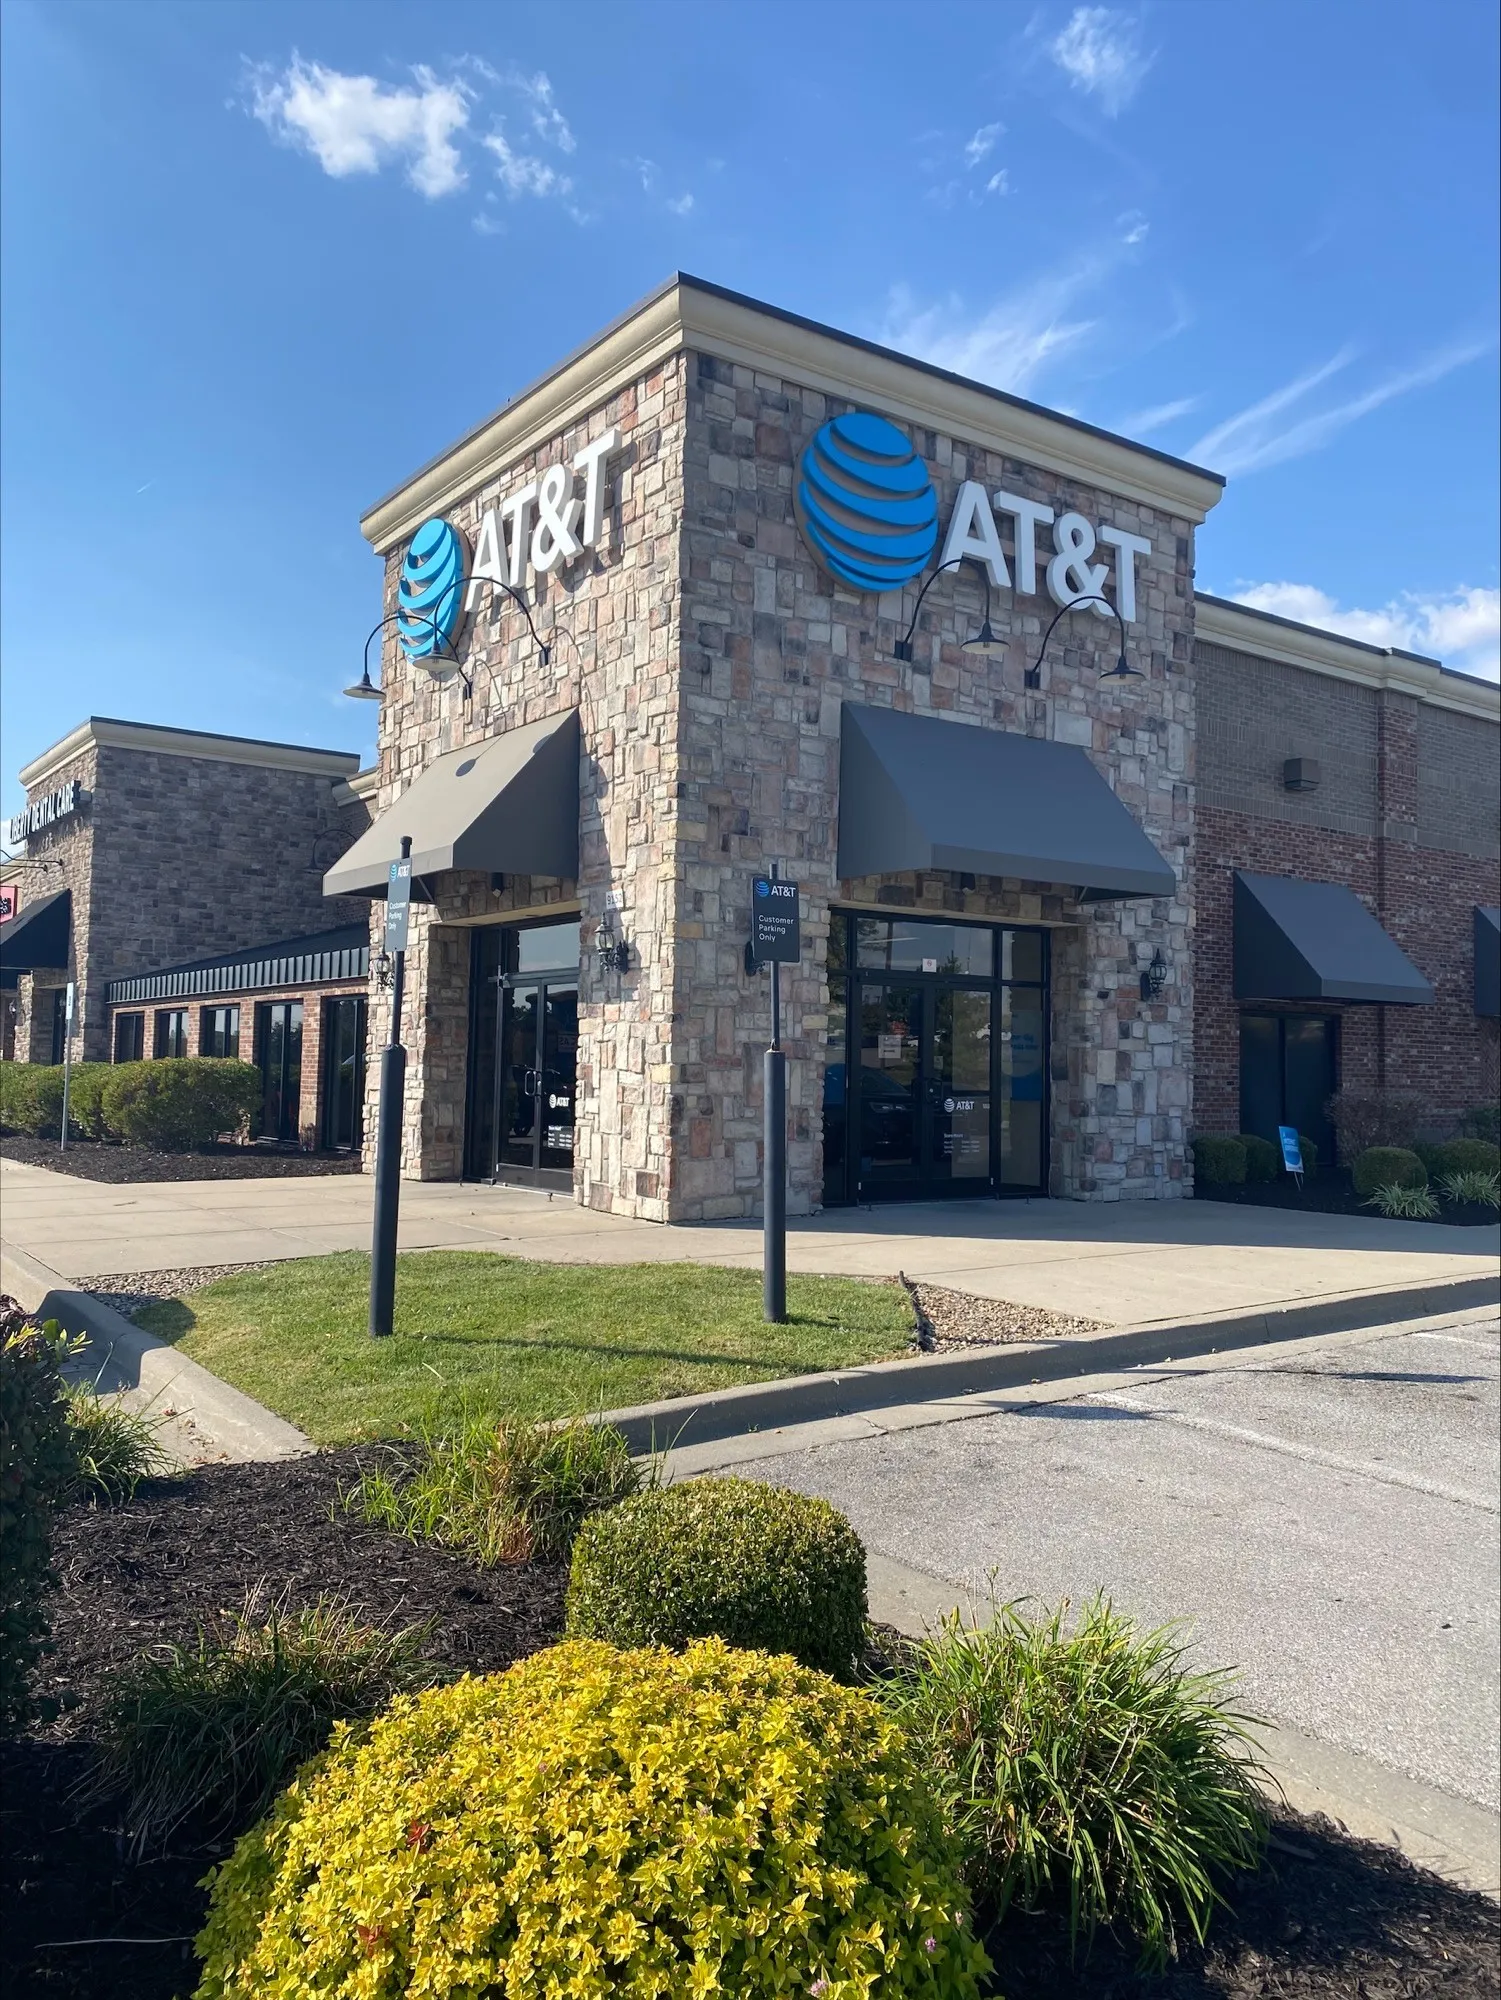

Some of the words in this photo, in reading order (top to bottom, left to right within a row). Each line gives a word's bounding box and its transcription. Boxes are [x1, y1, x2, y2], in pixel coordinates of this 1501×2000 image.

[465, 429, 621, 612] AT&T
[938, 480, 1152, 622] AT&T
[31, 792, 56, 832] DENTAL
[56, 780, 77, 819] CARE
[397, 864, 411, 878] AT&T
[770, 885, 796, 898] AT&T
[758, 914, 794, 925] Customer
[758, 923, 786, 935] Parking
[758, 932, 776, 943] Only
[556, 1097, 570, 1108] AT&T
[956, 1100, 975, 1111] AT&T
